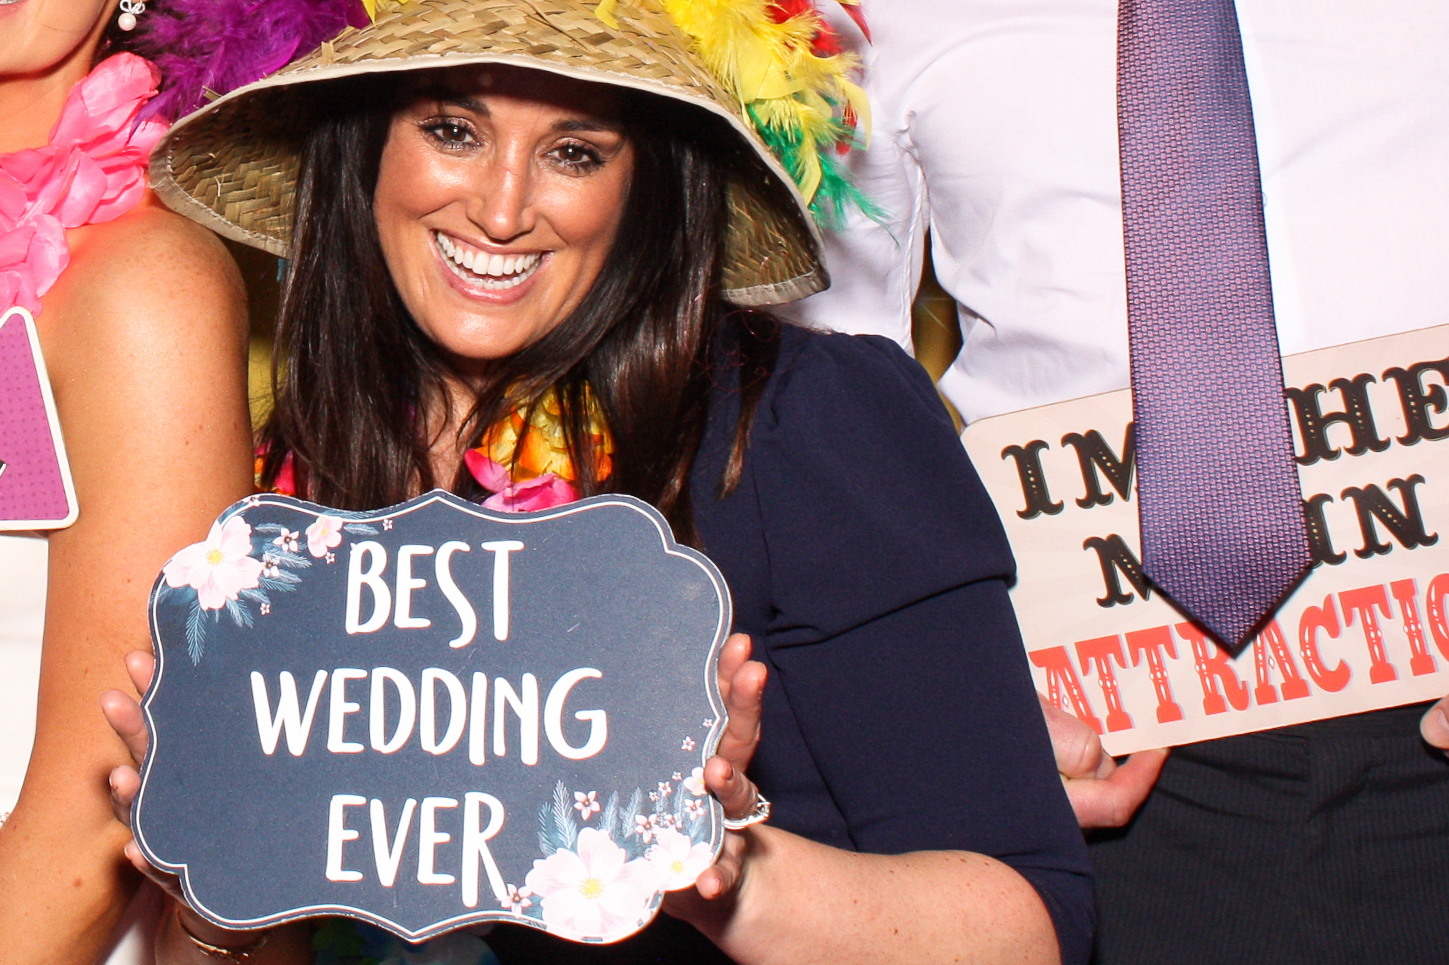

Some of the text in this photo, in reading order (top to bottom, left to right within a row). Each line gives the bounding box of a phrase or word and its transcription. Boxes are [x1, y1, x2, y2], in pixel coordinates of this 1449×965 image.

[1284, 355, 1449, 466] HE
[345, 540, 525, 648] BEST
[1083, 474, 1439, 607] MIN
[250, 667, 608, 766] WEDDING
[325, 792, 509, 908] EVER
